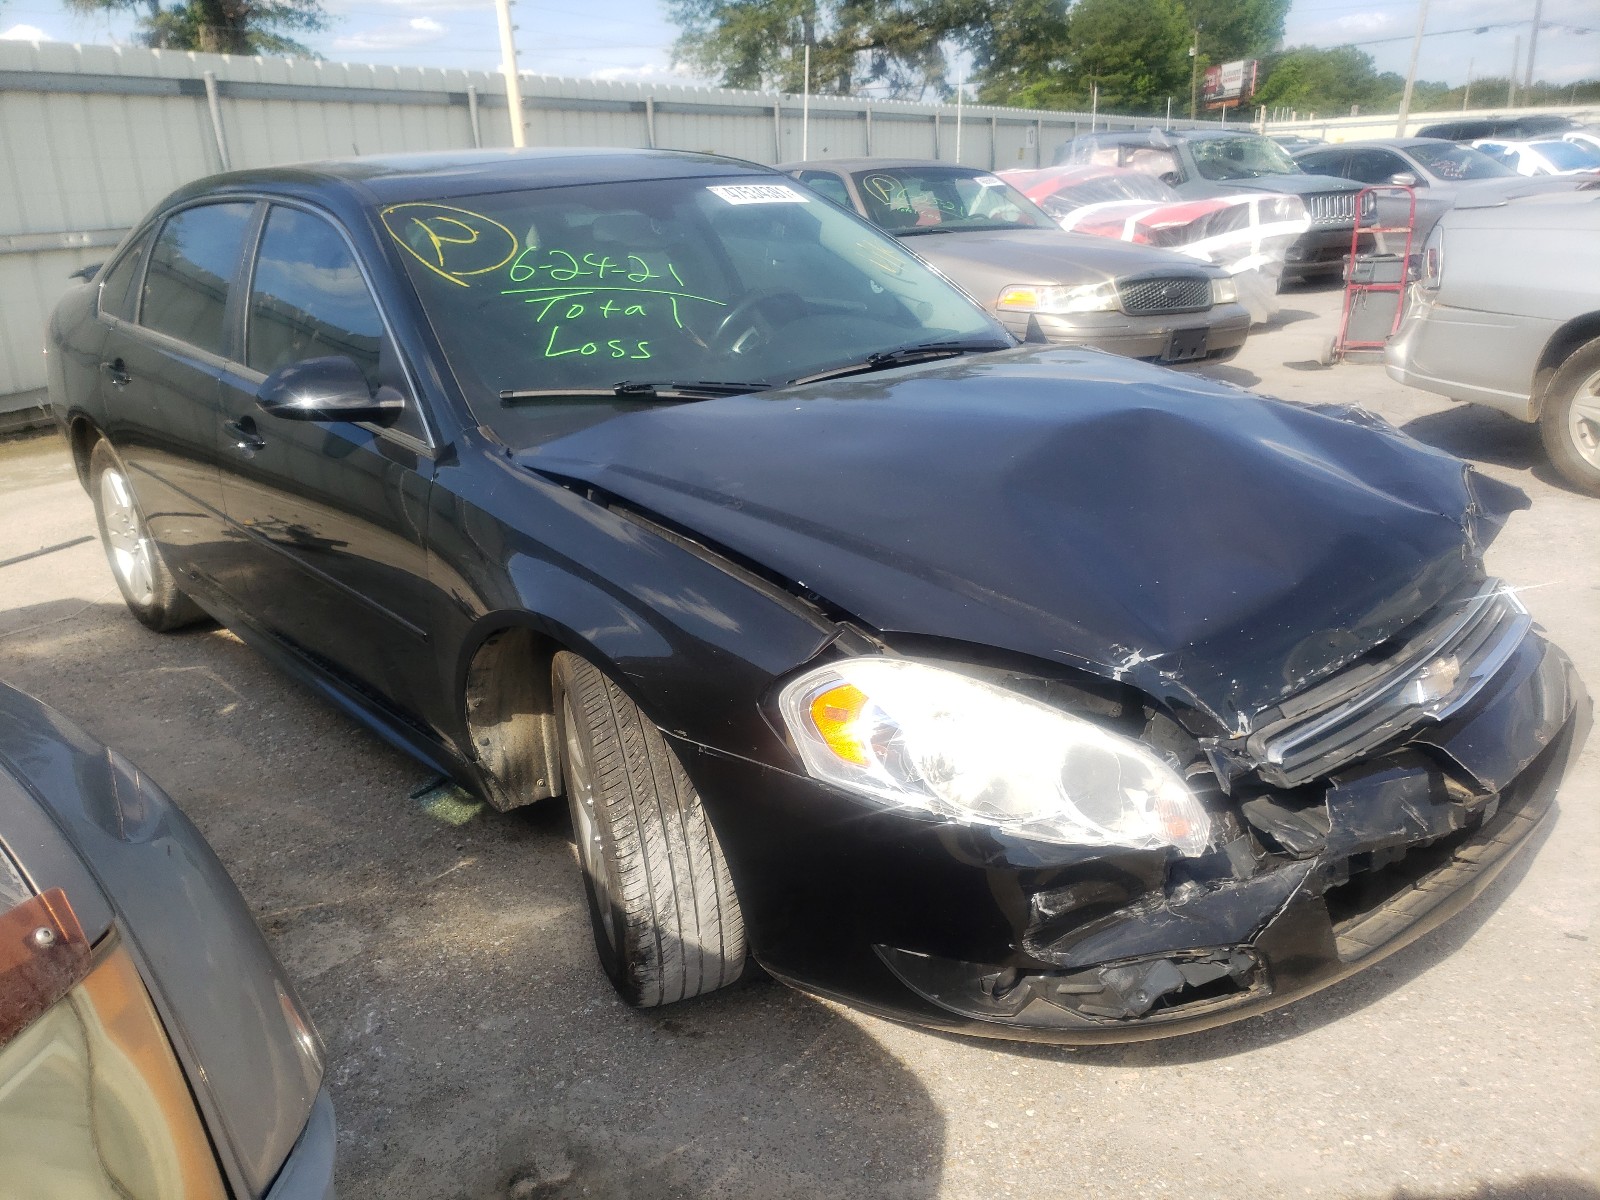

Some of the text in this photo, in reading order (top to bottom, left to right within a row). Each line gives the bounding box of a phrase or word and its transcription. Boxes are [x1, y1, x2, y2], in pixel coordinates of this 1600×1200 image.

[509, 246, 685, 287] 6-24-21
[524, 291, 684, 329] Total
[544, 325, 652, 359] Loss
